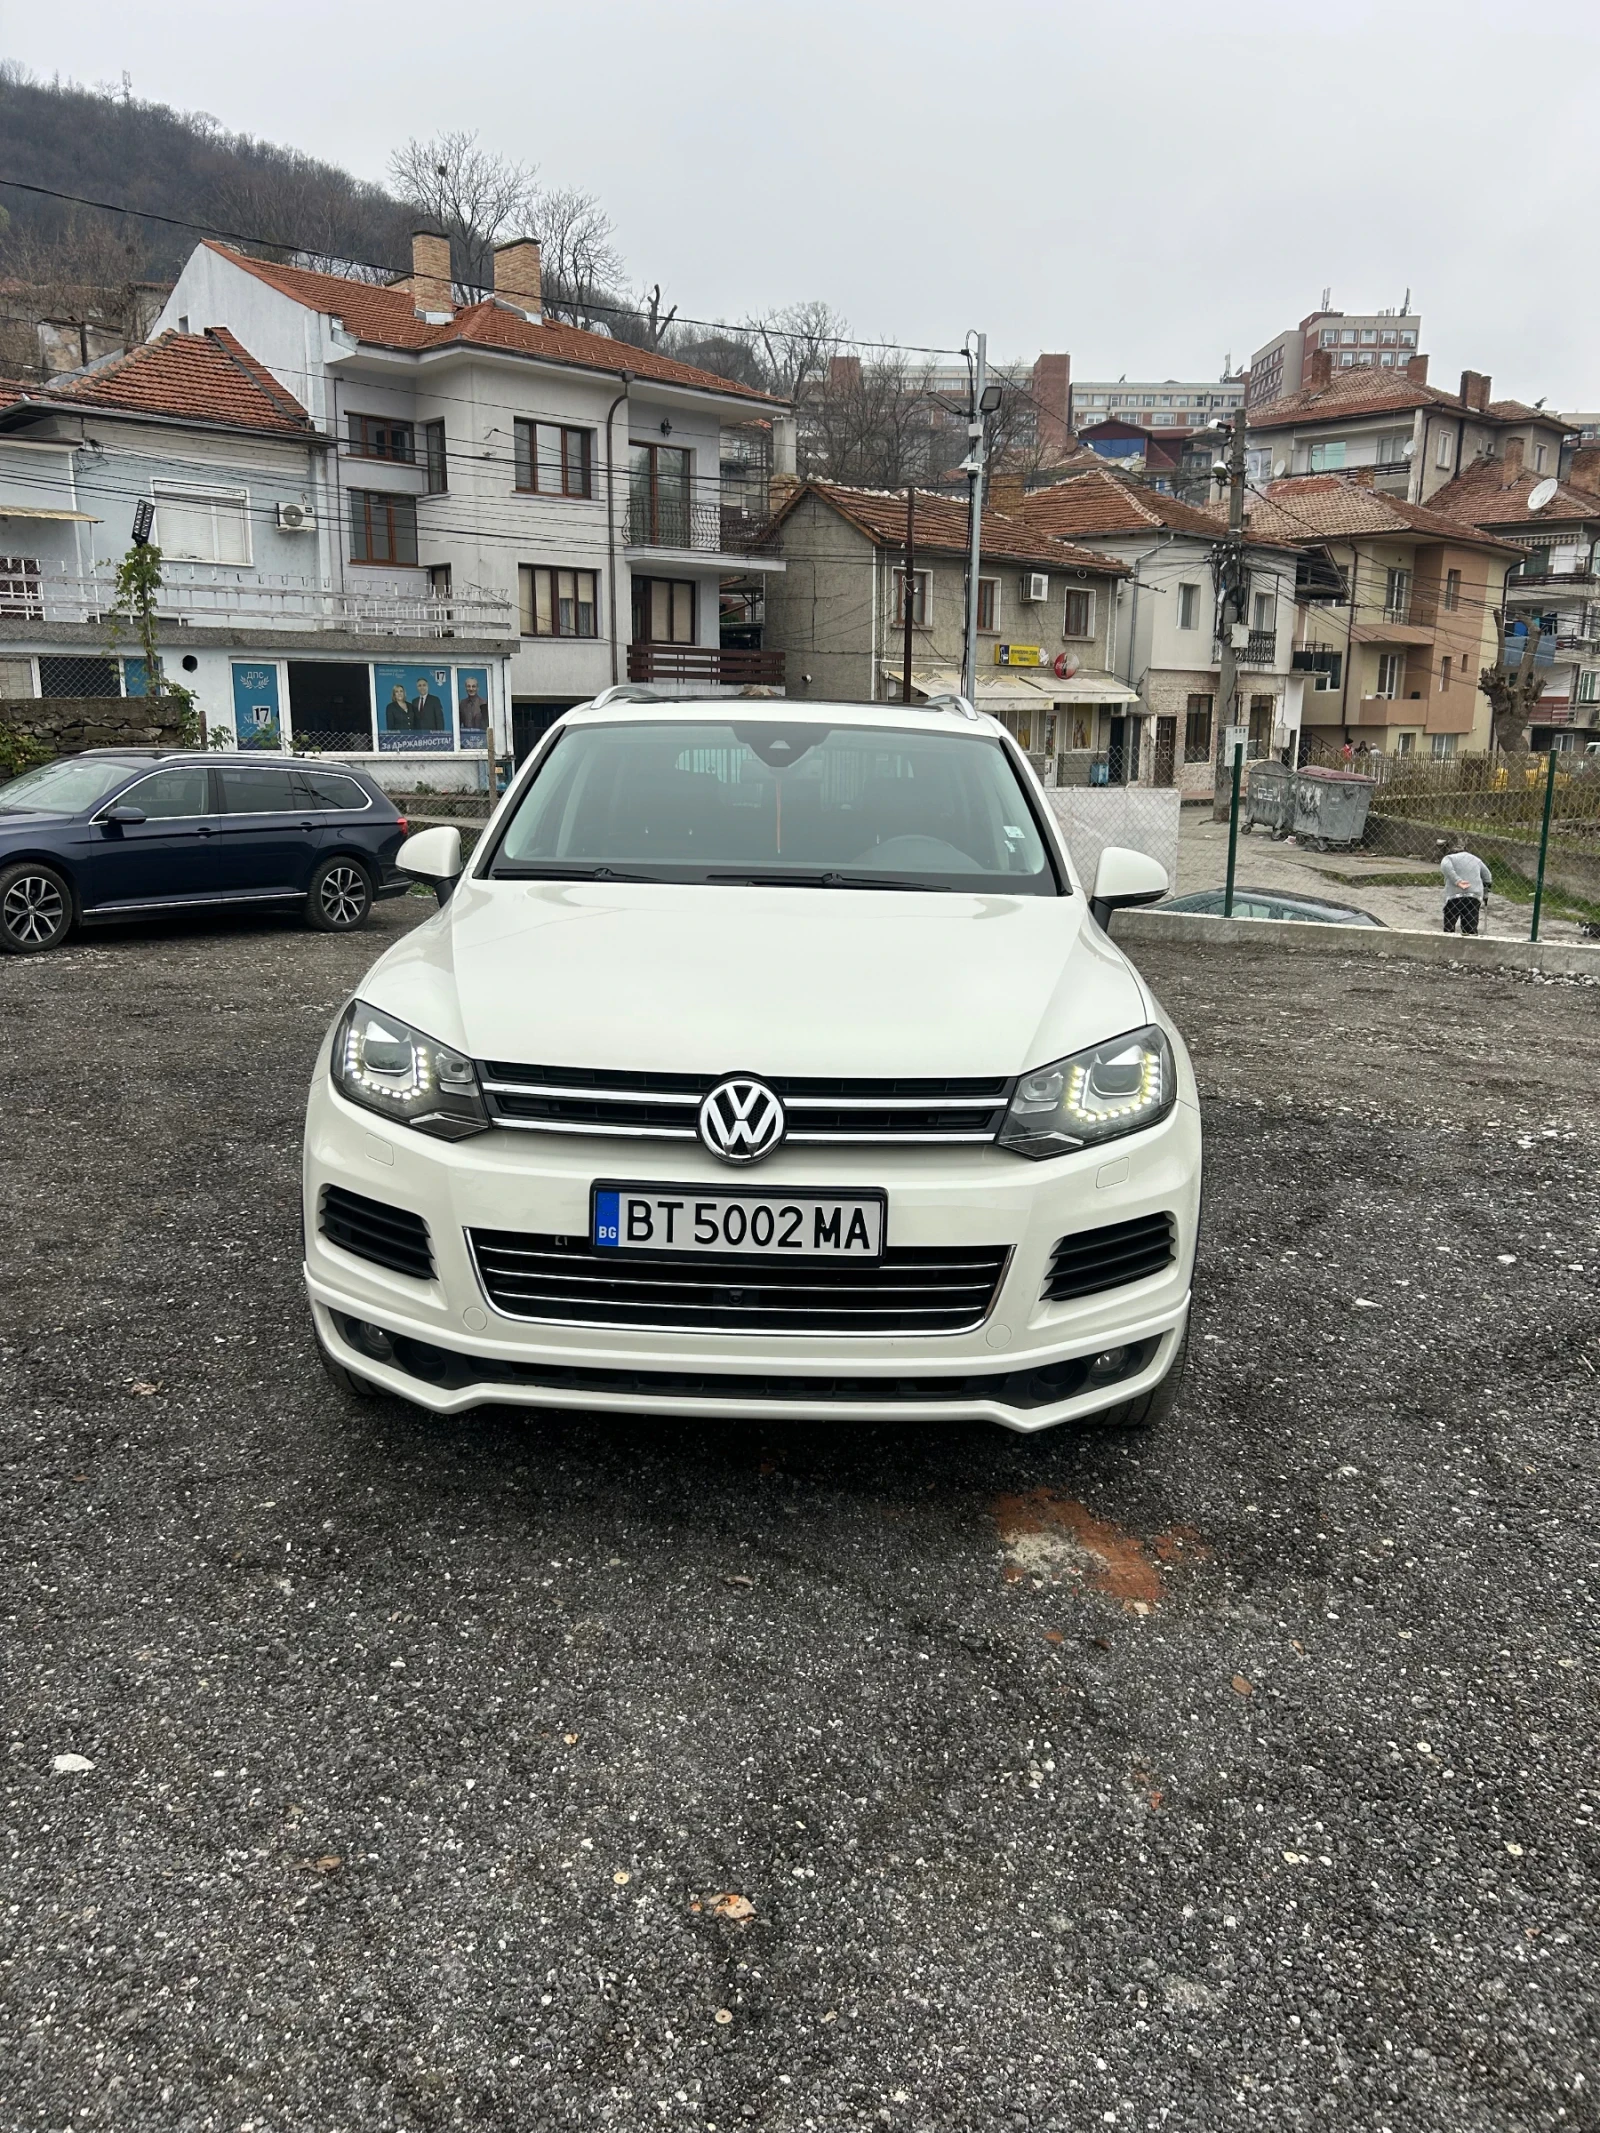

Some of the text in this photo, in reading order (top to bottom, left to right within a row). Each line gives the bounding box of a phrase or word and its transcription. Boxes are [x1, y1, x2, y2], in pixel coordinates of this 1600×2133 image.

[247, 671, 264, 679] ДПС
[436, 671, 445, 680] 17
[254, 708, 269, 722] 17
[382, 737, 451, 750] За ДЪРЖАВНОСТТА!
[627, 1199, 870, 1249] BT 5002 MA
[598, 1226, 617, 1239] BG
